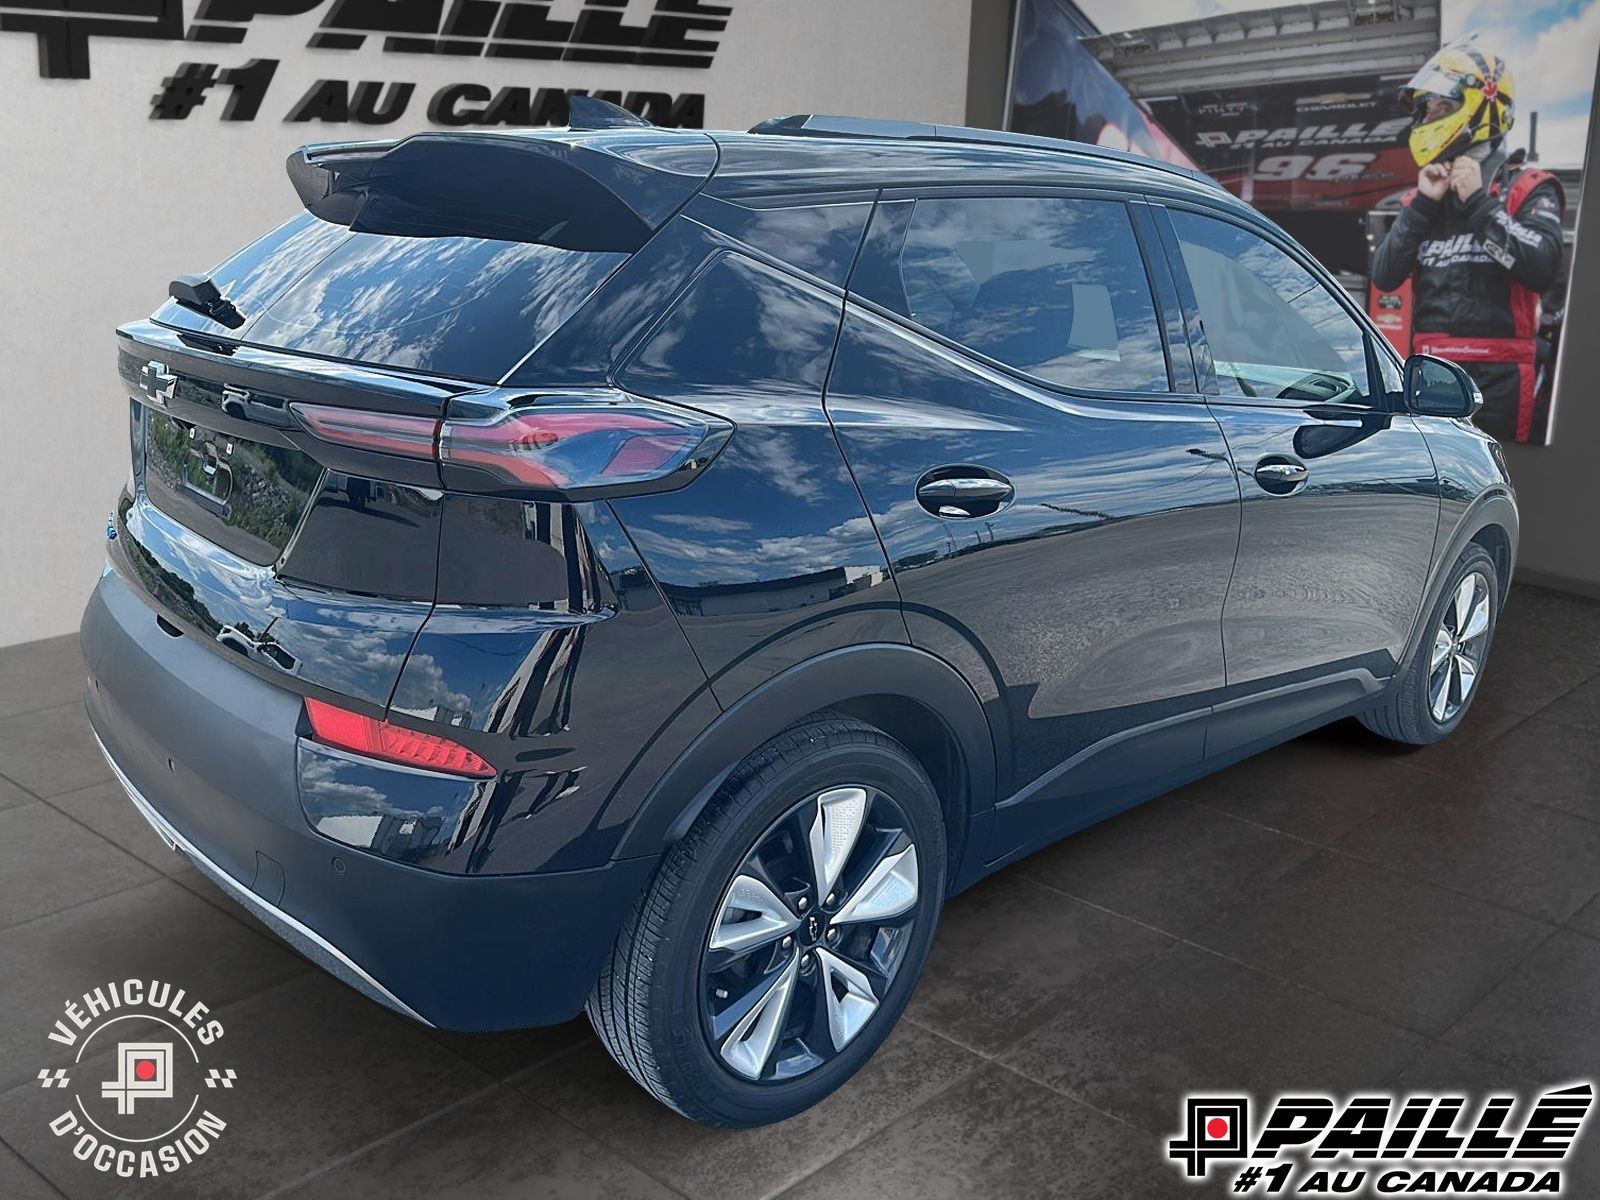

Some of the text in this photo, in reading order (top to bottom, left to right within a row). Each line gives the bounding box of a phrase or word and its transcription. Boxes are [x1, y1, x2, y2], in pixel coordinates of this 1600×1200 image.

[148, 58, 280, 121] #1
[282, 79, 417, 125] AU
[1296, 101, 1377, 113] CHEVROLET
[1261, 140, 1292, 148] AU
[1298, 136, 1398, 146] CANADA
[1254, 152, 1377, 181] 96
